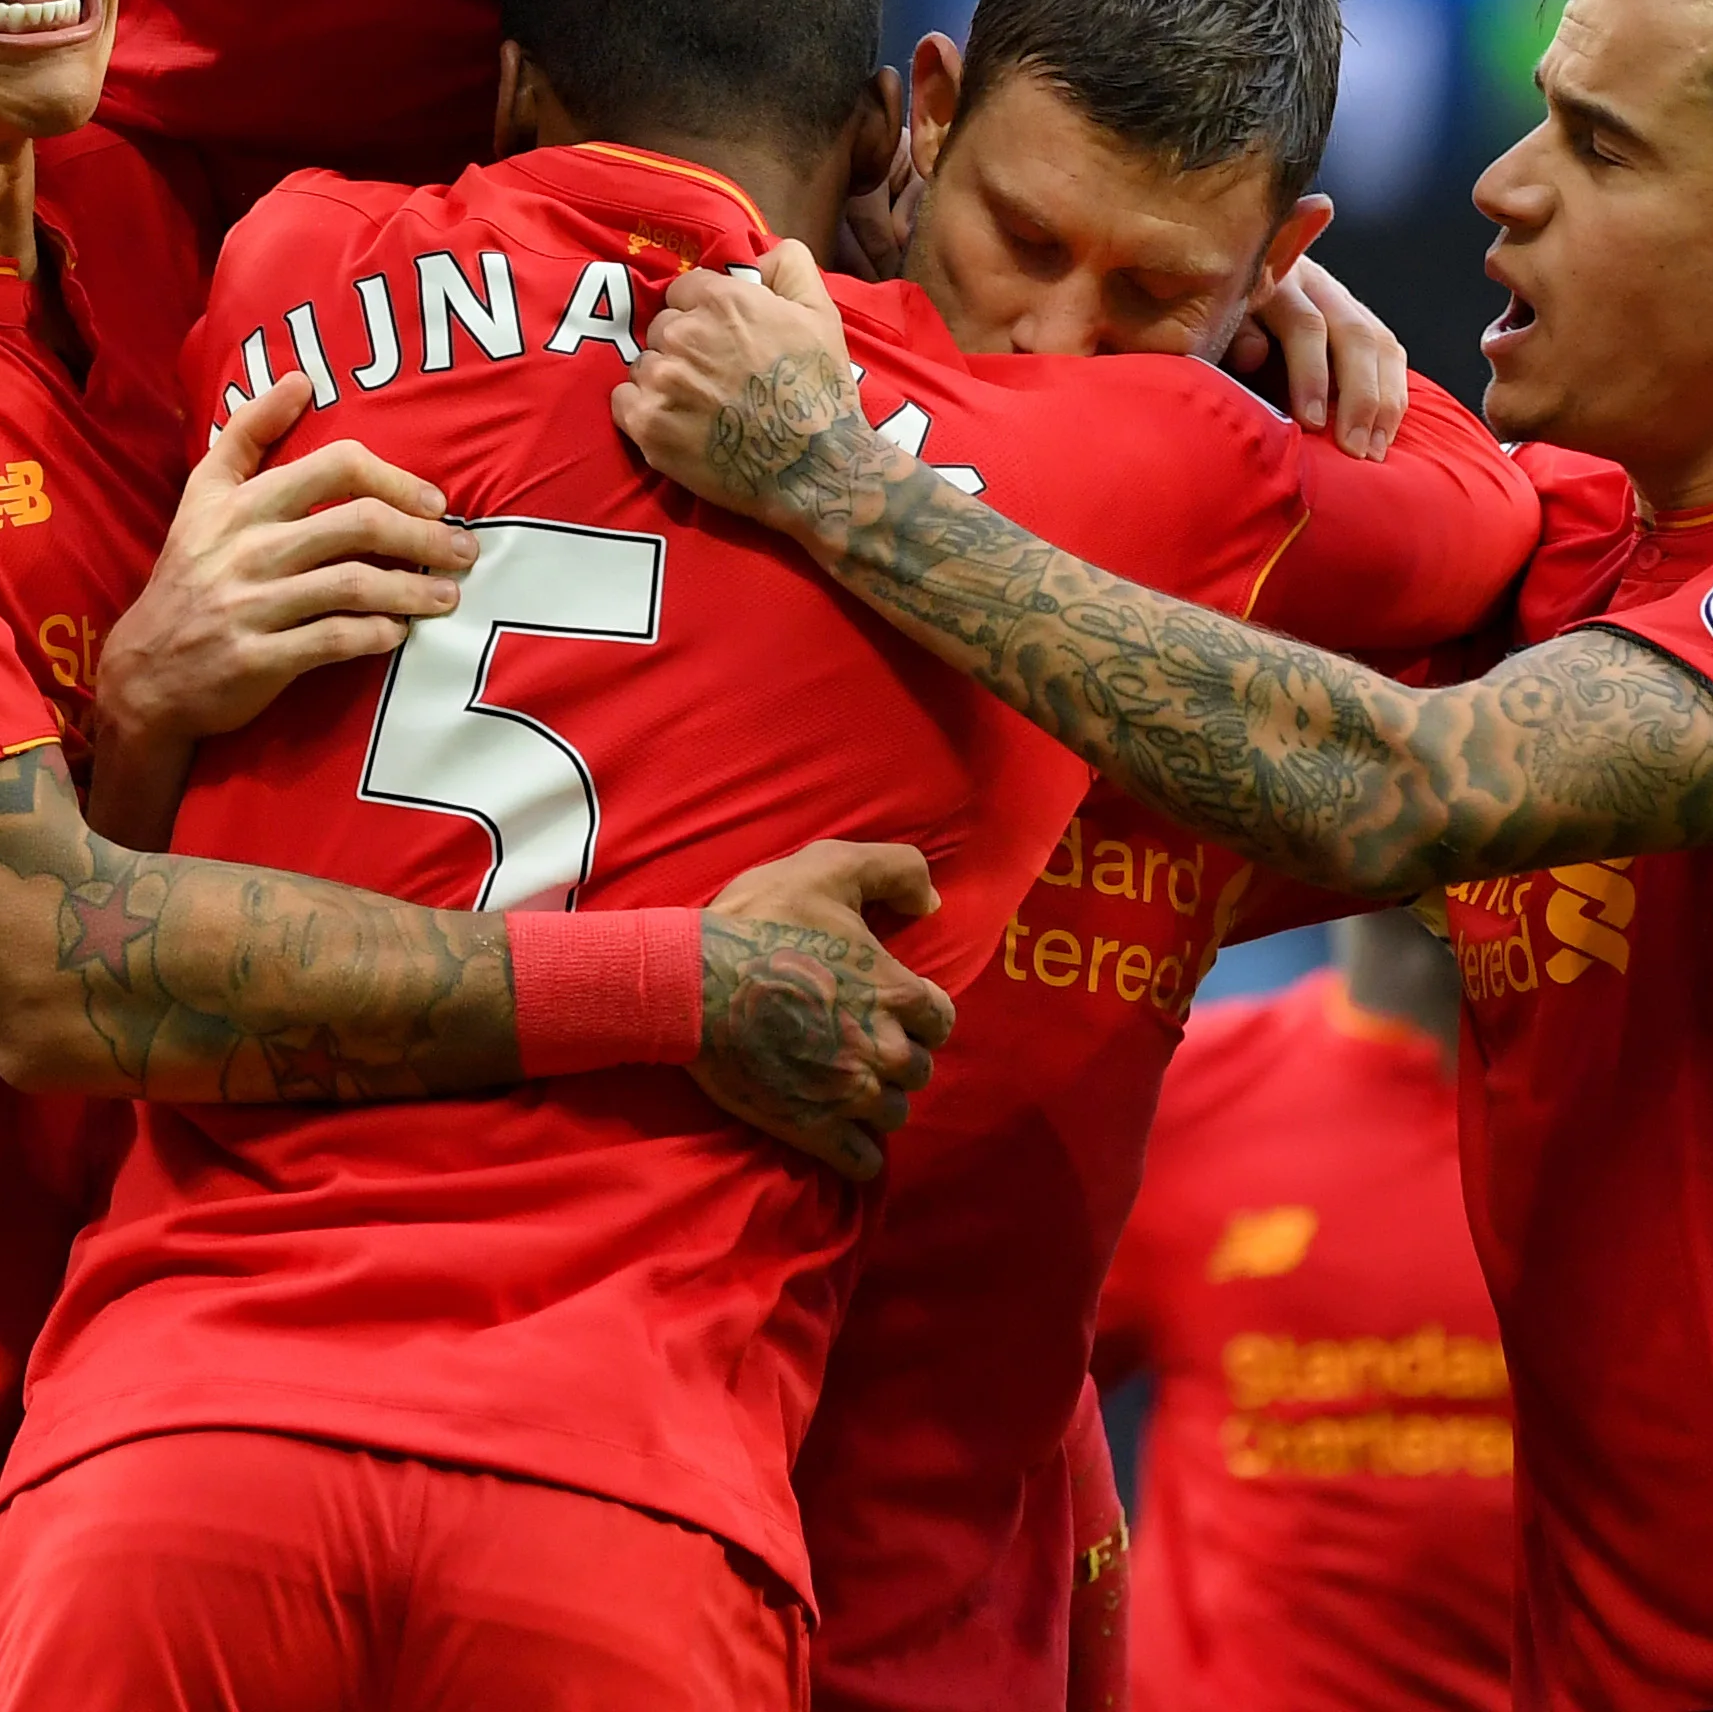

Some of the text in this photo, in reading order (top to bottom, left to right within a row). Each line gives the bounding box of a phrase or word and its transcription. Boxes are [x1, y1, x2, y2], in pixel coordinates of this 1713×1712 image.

[356, 516, 667, 912] 5
[1039, 816, 1204, 918] dard
[1003, 910, 1194, 1019] tered
